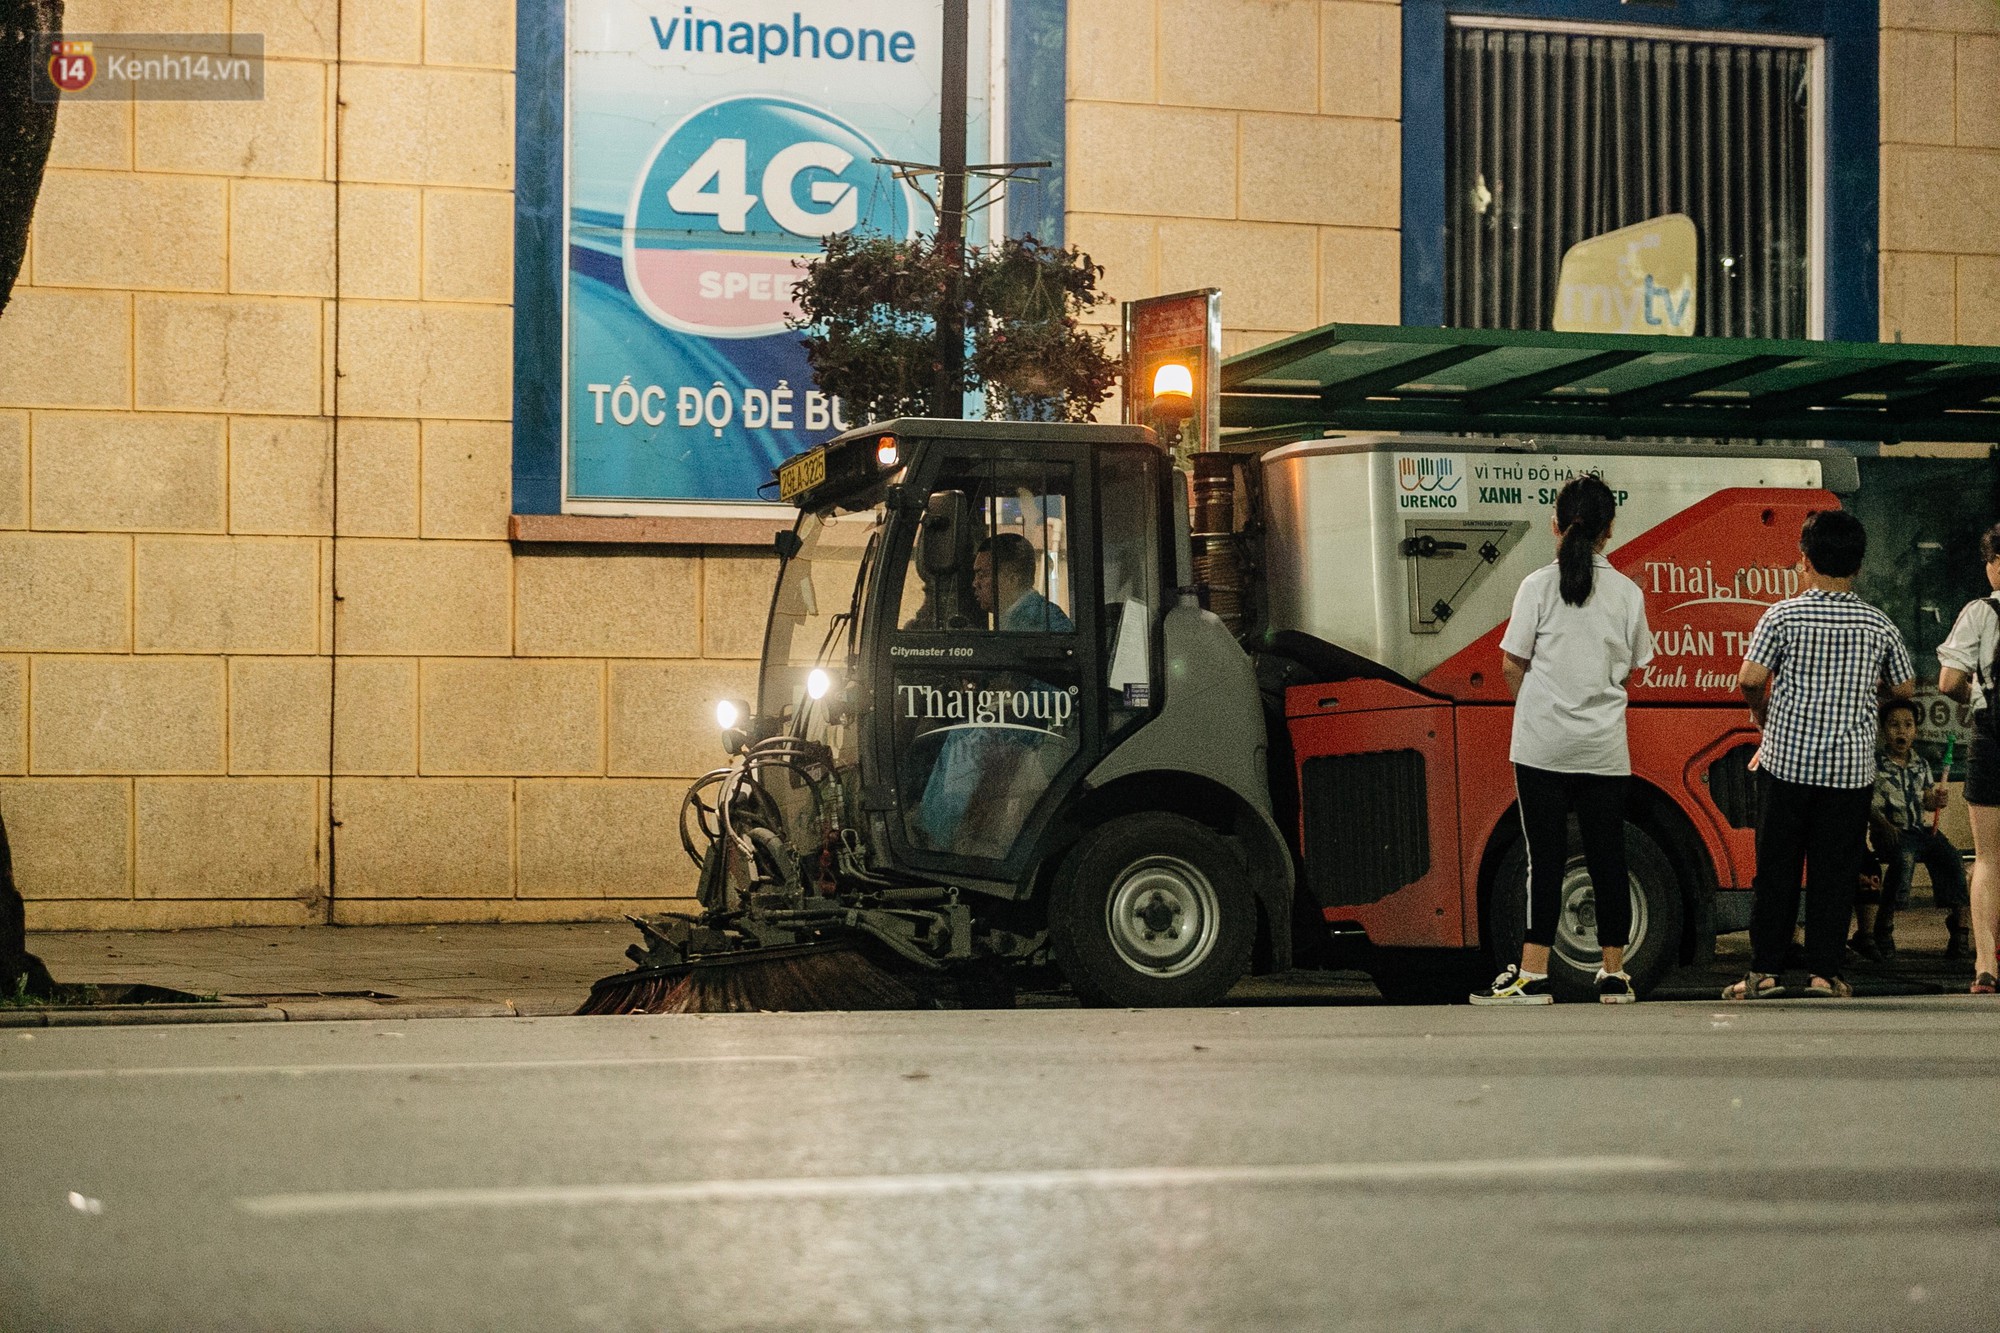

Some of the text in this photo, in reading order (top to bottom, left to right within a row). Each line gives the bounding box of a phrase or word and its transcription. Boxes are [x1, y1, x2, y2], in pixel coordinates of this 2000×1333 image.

[650, 6, 916, 64] vinaphone
[667, 138, 858, 238] 4G
[698, 270, 800, 301] SPEE
[1562, 273, 1692, 334] mytv
[588, 375, 667, 428] TỐC
[676, 380, 733, 438] ĐỘ
[742, 379, 794, 430] ĐỂ
[1474, 465, 1489, 480] VÌ
[1493, 462, 1523, 480] THỦ
[1528, 463, 1550, 481] ĐÔ
[1555, 465, 1574, 481] HÀ
[1400, 494, 1458, 508] URENCO
[1479, 486, 1522, 504] XANH
[890, 646, 974, 658] Citymaster 1600
[1648, 623, 1714, 656] XUÂN
[1634, 665, 1740, 692] Kính tặng
